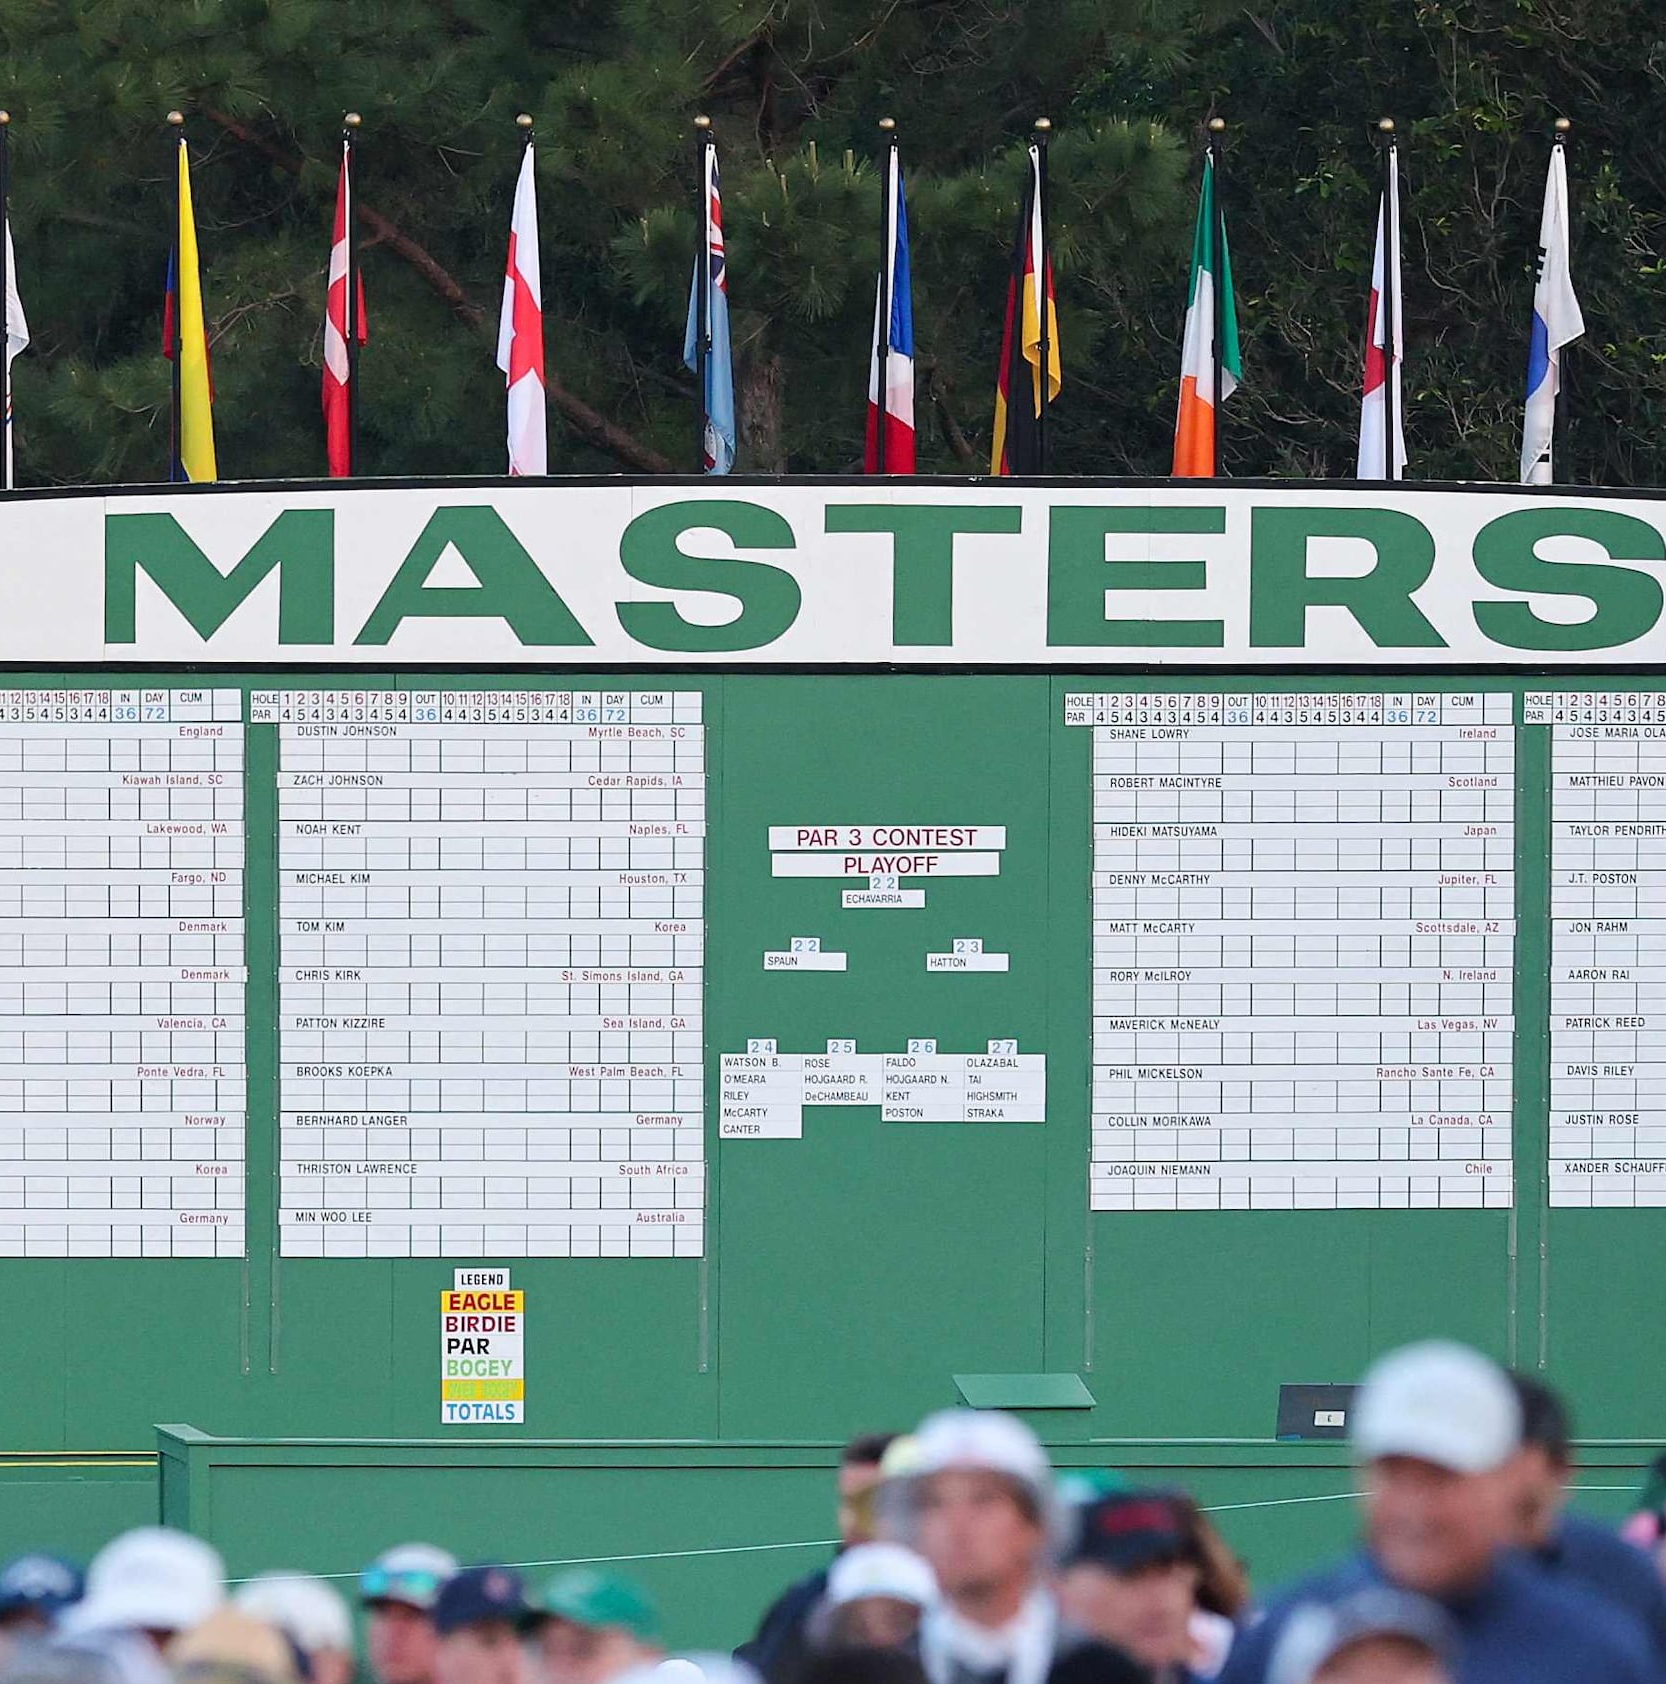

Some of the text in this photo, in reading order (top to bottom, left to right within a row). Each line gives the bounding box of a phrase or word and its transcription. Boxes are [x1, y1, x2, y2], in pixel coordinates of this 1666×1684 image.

[105, 501, 1666, 651] MASTERS
[1065, 696, 1093, 707] HOLE
[1227, 696, 1249, 708] OUT
[1393, 696, 1403, 706] IN
[1417, 696, 1435, 706] DAY
[1451, 696, 1474, 706] CUM
[179, 726, 223, 738] England
[297, 725, 397, 736] DUSTIN JOHNSON
[588, 727, 623, 739] Myrtle
[670, 727, 685, 738] SC
[1110, 728, 1189, 740] SHANE LOWRY
[1459, 728, 1497, 739] Ireland
[211, 823, 227, 834] WA
[1111, 826, 1217, 837] HIDEKI MATSUYAMA
[1464, 825, 1497, 838] Japan
[1569, 825, 1609, 836] TAYLOR
[797, 828, 978, 846] PAR 3 CONTEST
[845, 856, 938, 874] PLAYOFF
[846, 894, 903, 904] ECHAVARRIA
[767, 956, 798, 966] SPAUN
[930, 957, 967, 968] HATTON
[1110, 971, 1140, 982] RORY
[1459, 970, 1496, 981] Ireland
[724, 1057, 766, 1067] WATSON
[805, 1058, 830, 1068] ROSE
[886, 1057, 916, 1068] FALDO
[967, 1058, 1019, 1068] OLAZABAL
[297, 1066, 392, 1077] BROOKS KOEPKA
[569, 1066, 595, 1077] West
[600, 1066, 625, 1077] Palm
[671, 1066, 684, 1077] FL
[1109, 1068, 1203, 1079] PHIL MICKELSON
[1376, 1067, 1417, 1078] Rancho
[1479, 1066, 1495, 1077] CA
[723, 1091, 749, 1101] RILEY
[805, 1091, 869, 1102] DeCHAMBEAU
[967, 1091, 1017, 1101] HIGHSMITH
[185, 1115, 225, 1127] Norway
[1565, 1162, 1609, 1173] XANDER
[461, 1274, 503, 1286] LEGEND
[449, 1293, 515, 1311] EAGLE
[446, 1316, 515, 1332] BIRDIE
[447, 1338, 489, 1355] PAR
[447, 1359, 513, 1377] BOGEY
[446, 1403, 515, 1420] TOTALS
